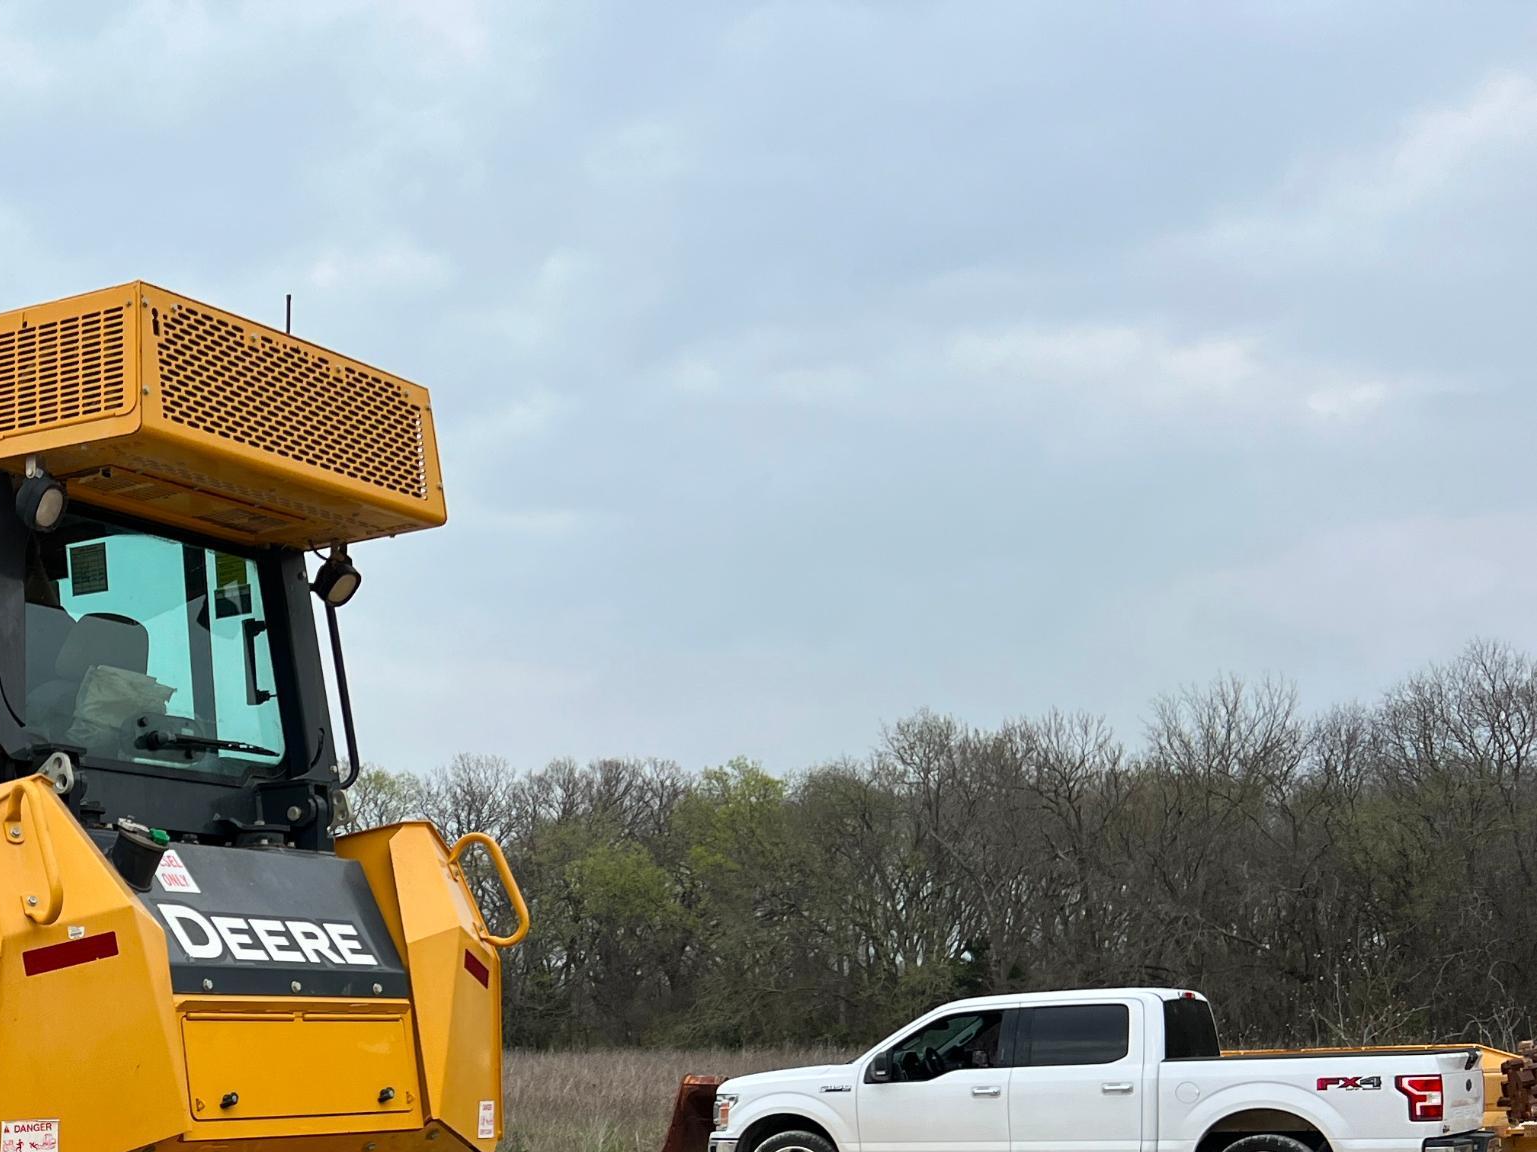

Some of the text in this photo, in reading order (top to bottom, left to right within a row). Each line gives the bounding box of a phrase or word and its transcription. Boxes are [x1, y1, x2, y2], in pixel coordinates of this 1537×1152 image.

[161, 872, 190, 888] ONLY
[157, 903, 378, 966] DEERE
[1317, 1076, 1382, 1091] FX4
[14, 1122, 52, 1133] DANGER
